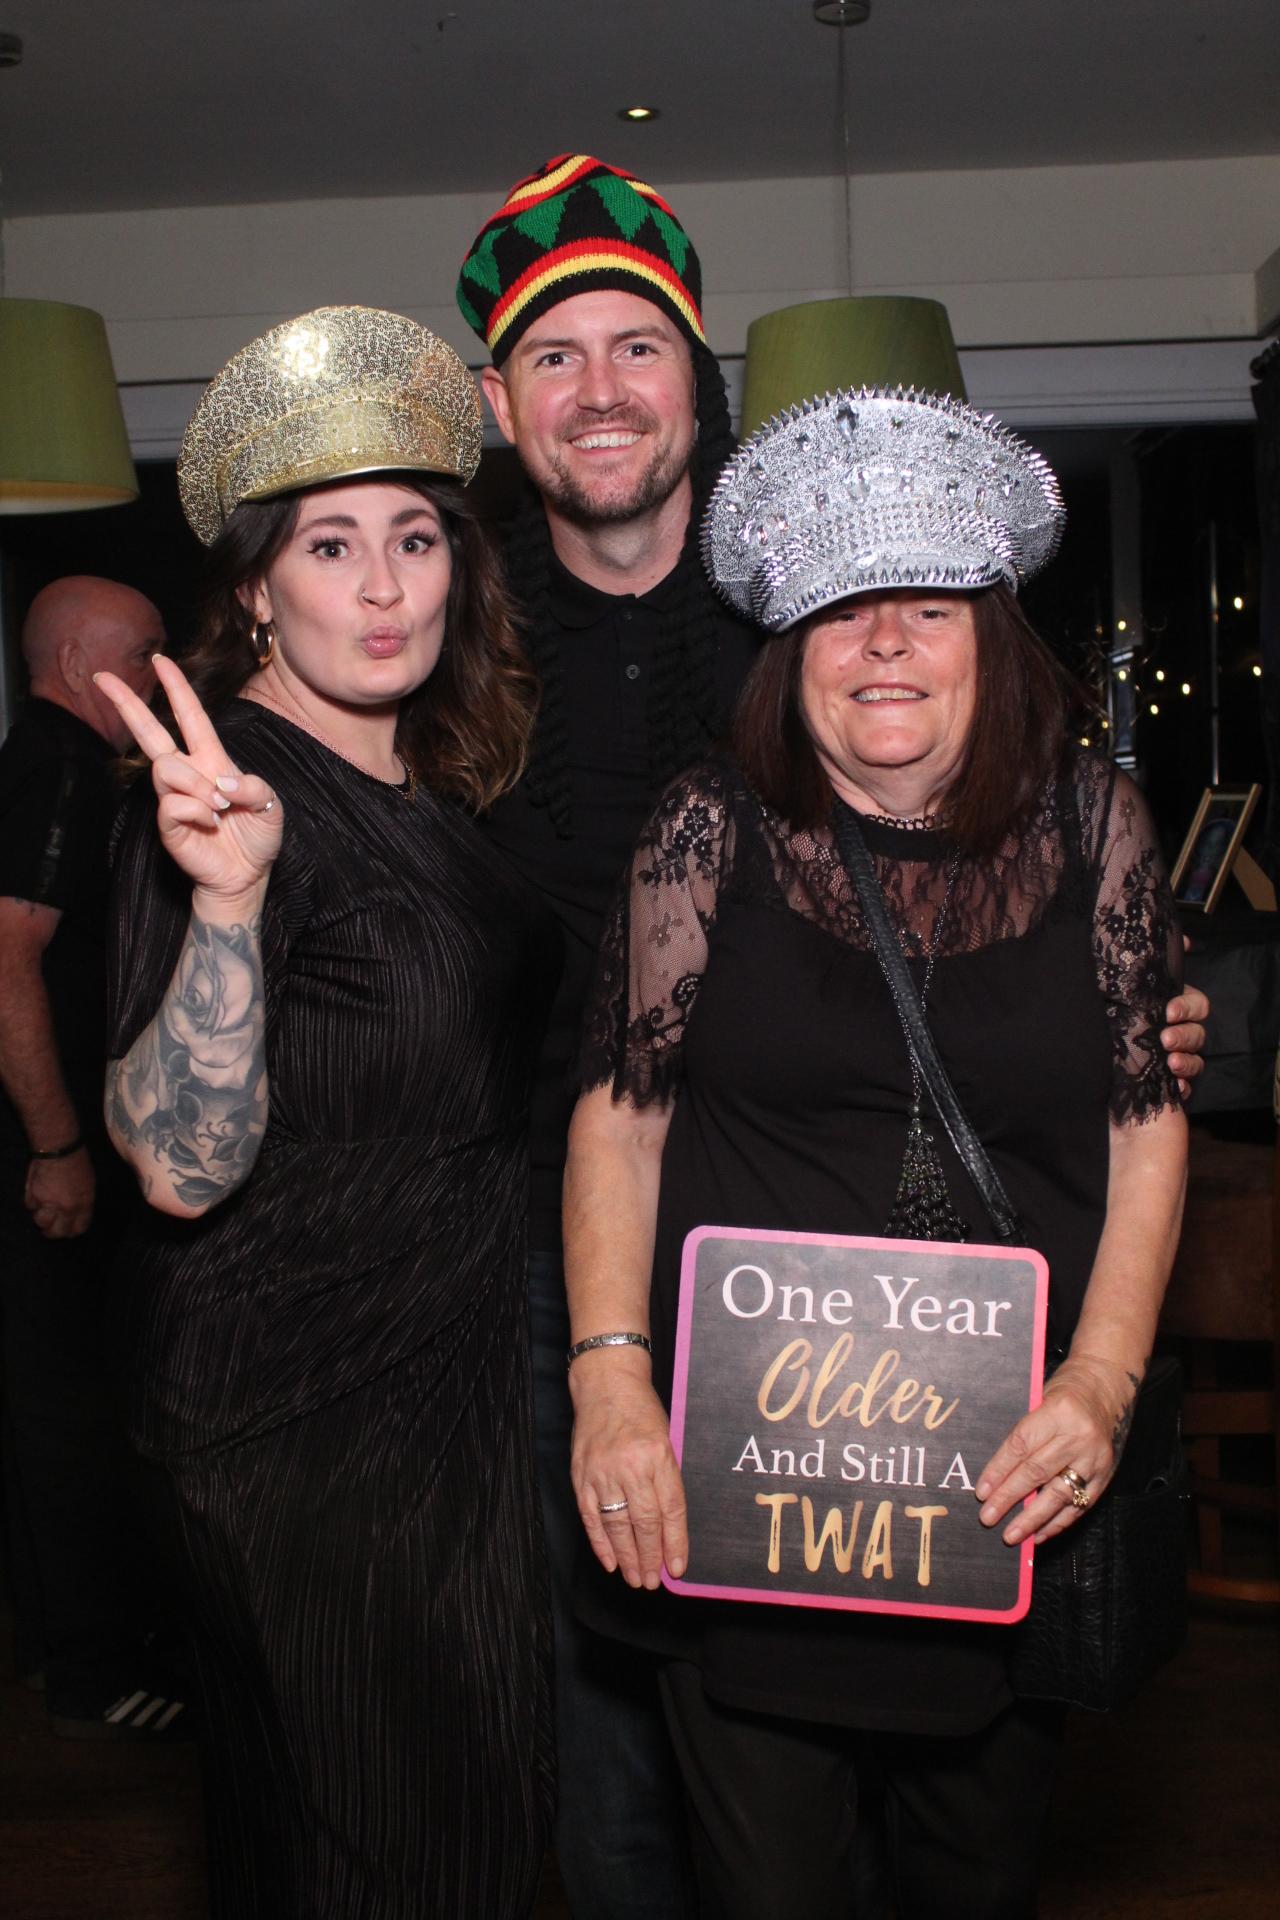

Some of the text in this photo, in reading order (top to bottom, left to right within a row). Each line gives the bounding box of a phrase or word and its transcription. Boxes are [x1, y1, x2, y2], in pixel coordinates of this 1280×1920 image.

[722, 1265, 1012, 1337] One Year
[757, 1332, 960, 1430] Older
[731, 1435, 976, 1491] And Still A
[755, 1493, 949, 1587] TWAT
